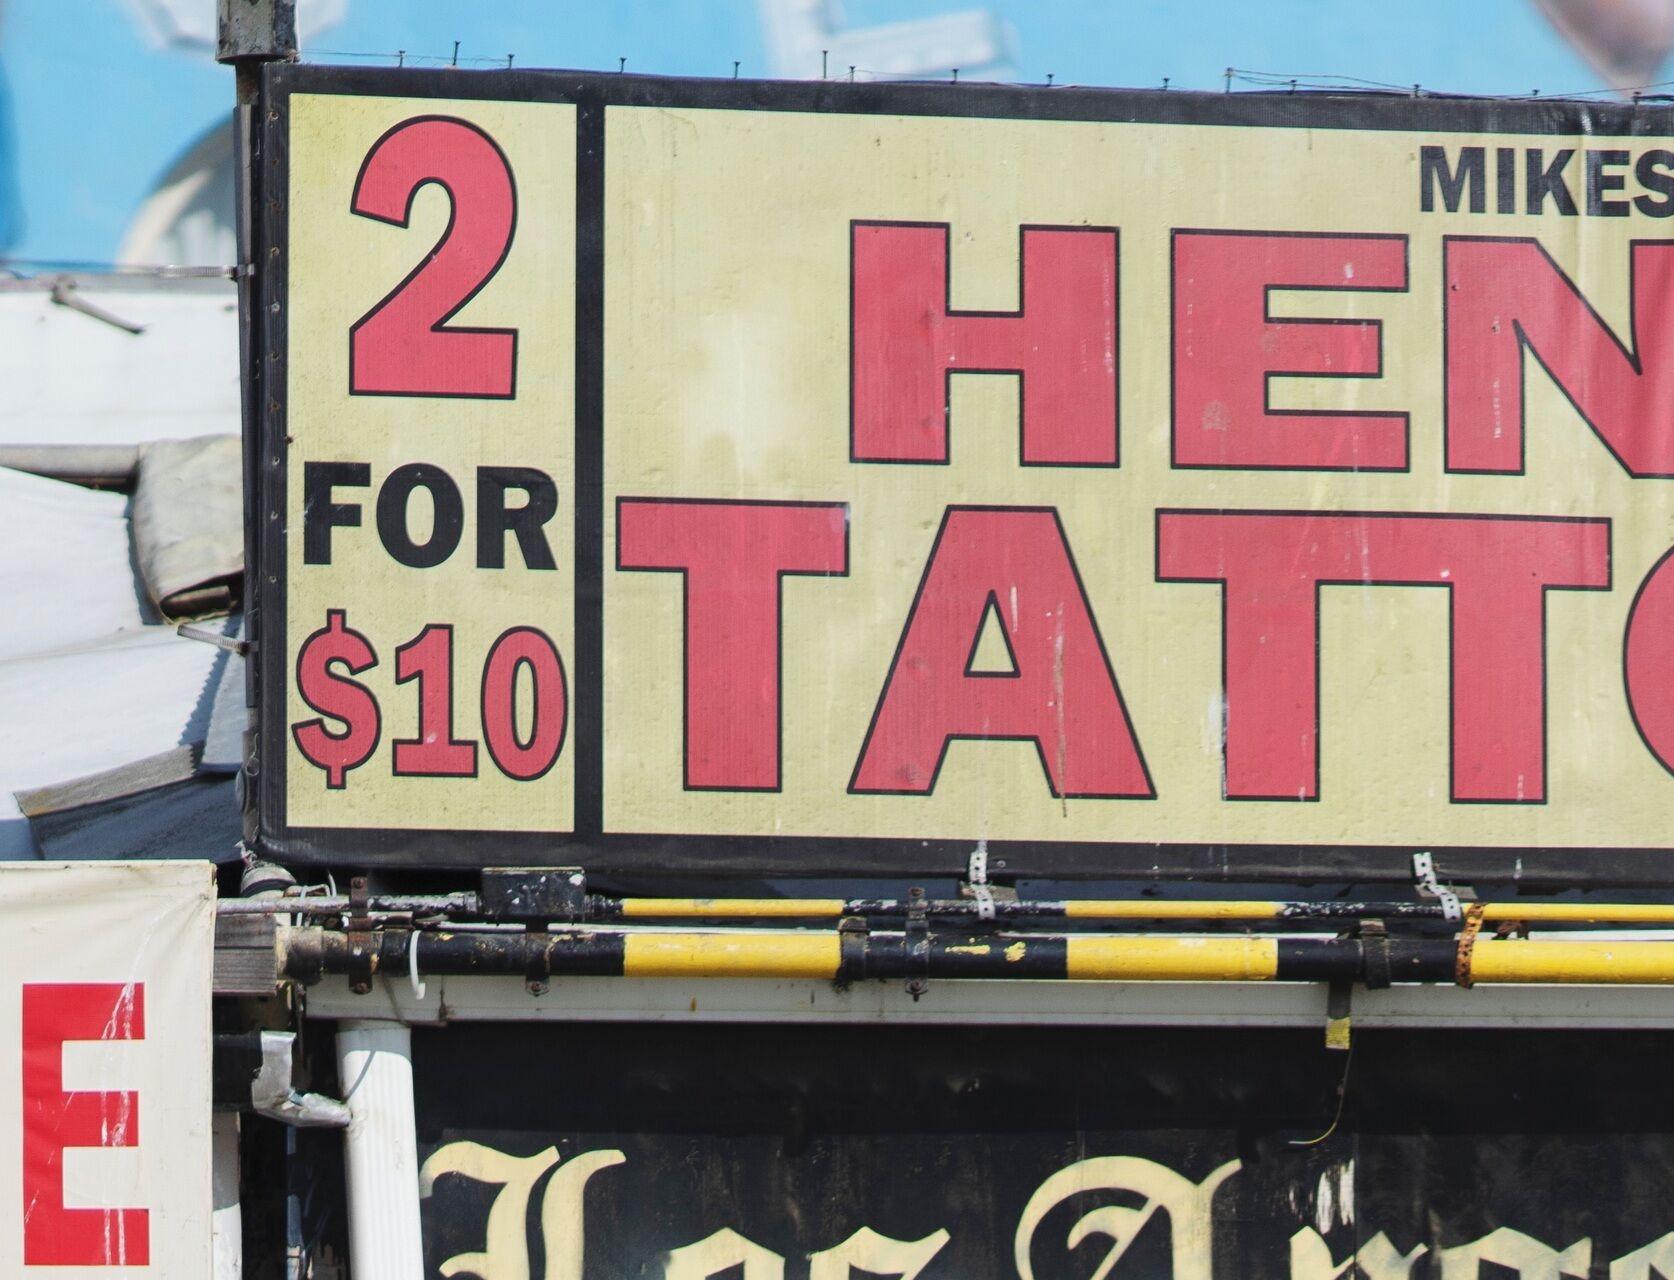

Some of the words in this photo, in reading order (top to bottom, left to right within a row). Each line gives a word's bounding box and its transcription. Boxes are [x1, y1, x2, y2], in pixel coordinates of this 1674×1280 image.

[349, 114, 518, 400] 2
[303, 460, 559, 571] FOR
[291, 608, 568, 790] $10
